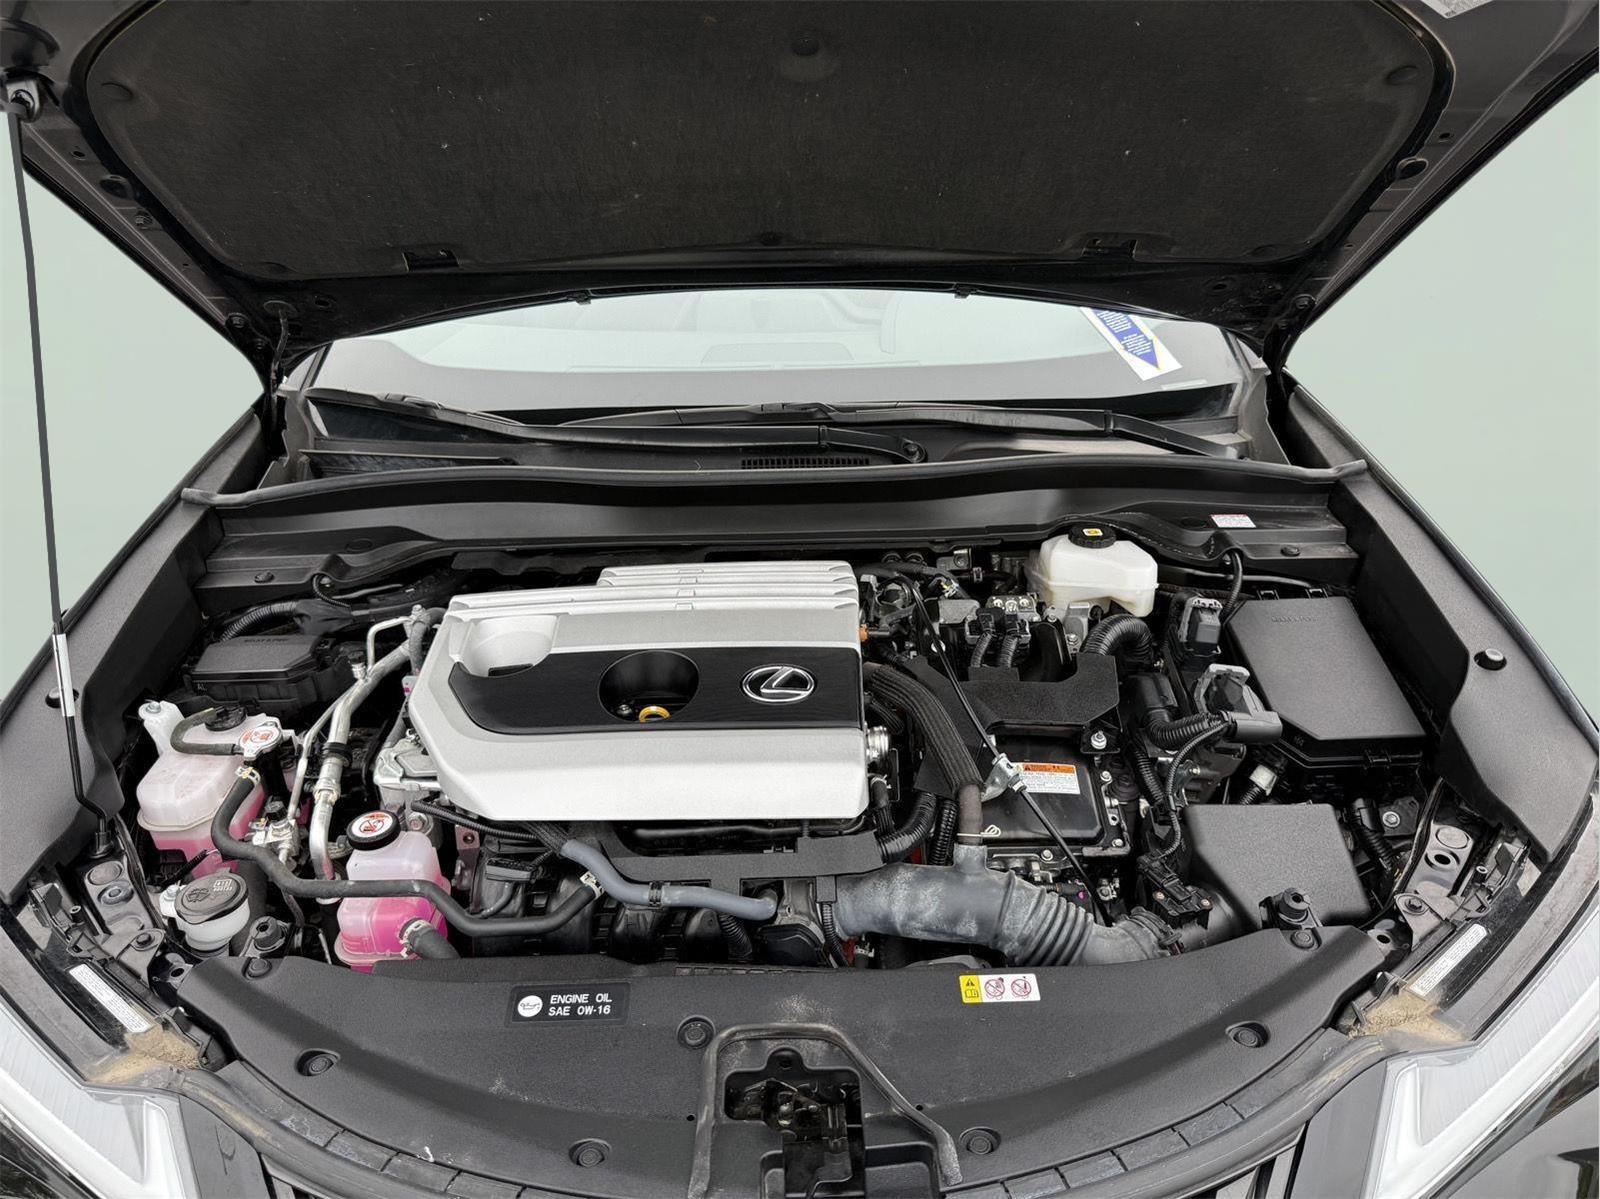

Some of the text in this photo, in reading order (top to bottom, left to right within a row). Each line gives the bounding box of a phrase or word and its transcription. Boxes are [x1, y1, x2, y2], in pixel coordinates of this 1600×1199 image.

[550, 993, 613, 1004] ENGINE OIL
[548, 1005, 611, 1016] SAE 0W-16
